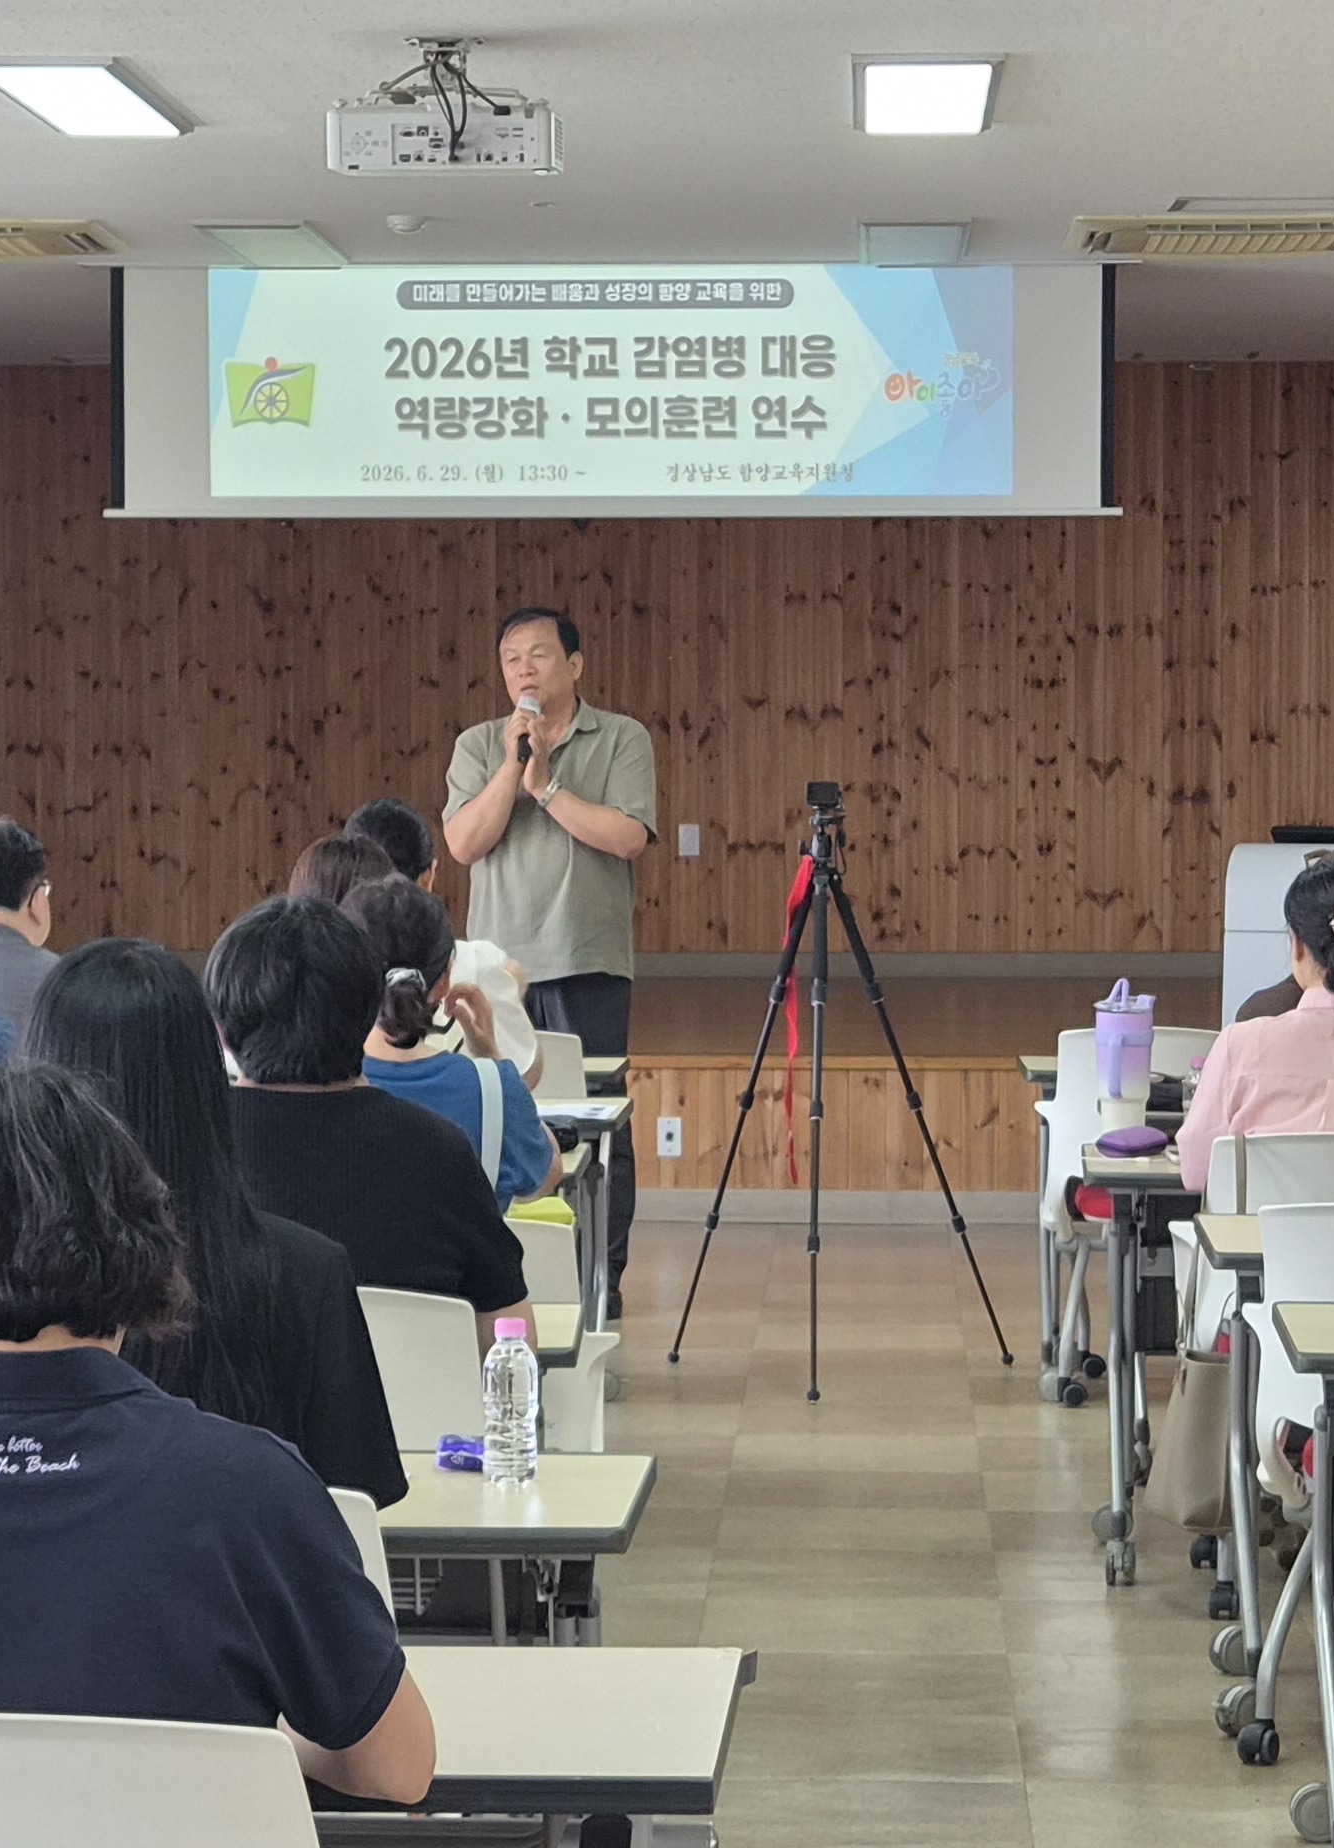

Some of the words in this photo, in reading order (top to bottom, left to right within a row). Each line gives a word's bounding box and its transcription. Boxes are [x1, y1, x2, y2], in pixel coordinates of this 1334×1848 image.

[412, 283, 460, 302] 미래를
[465, 283, 547, 302] 만들어가는
[551, 283, 600, 302] 배움과
[604, 282, 653, 302] 성장의
[658, 281, 691, 302] 함양
[695, 281, 744, 302] 교육을
[748, 281, 782, 302] 위한
[384, 336, 530, 380] 2026년
[543, 335, 620, 380] 학교
[633, 334, 747, 380] 감염병
[760, 334, 838, 379] 대응
[394, 396, 550, 440] 역량강화
[585, 396, 738, 439] 모의훈련
[751, 395, 828, 439] 연수
[360, 464, 411, 482] 2026.
[416, 464, 434, 482] 6.
[439, 464, 468, 482] 29.
[475, 463, 504, 484] (월)
[518, 464, 568, 482] 13:30
[666, 463, 733, 483] 경상남도
[738, 463, 855, 483] 함양교육지원청
[7, 1435, 44, 1453] better
[25, 1451, 81, 1474] Beach
